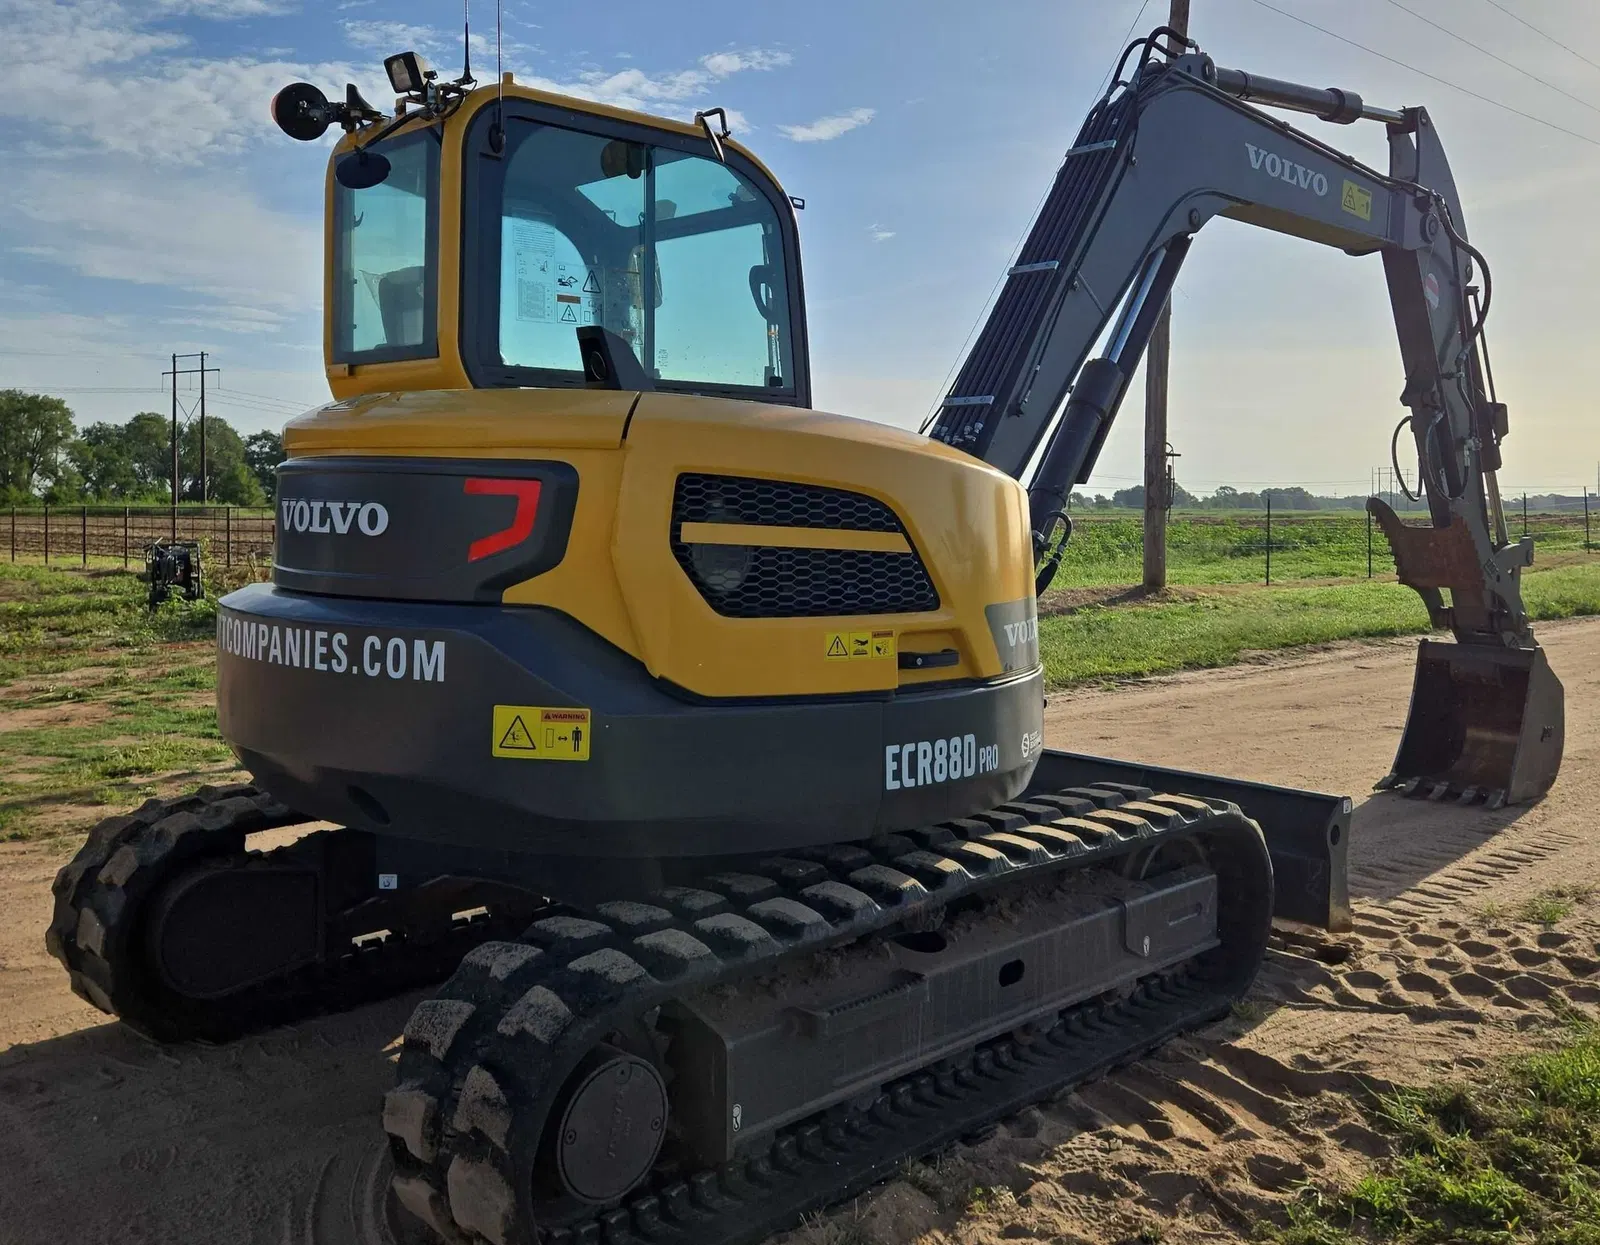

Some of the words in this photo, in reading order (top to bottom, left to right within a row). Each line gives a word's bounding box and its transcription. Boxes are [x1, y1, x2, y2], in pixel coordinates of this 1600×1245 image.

[1245, 143, 1328, 196] VOLVO
[281, 498, 389, 537] VOLVO
[551, 712, 585, 721] WARNING
[885, 733, 976, 791] ECR88D
[979, 743, 999, 774] PRO
